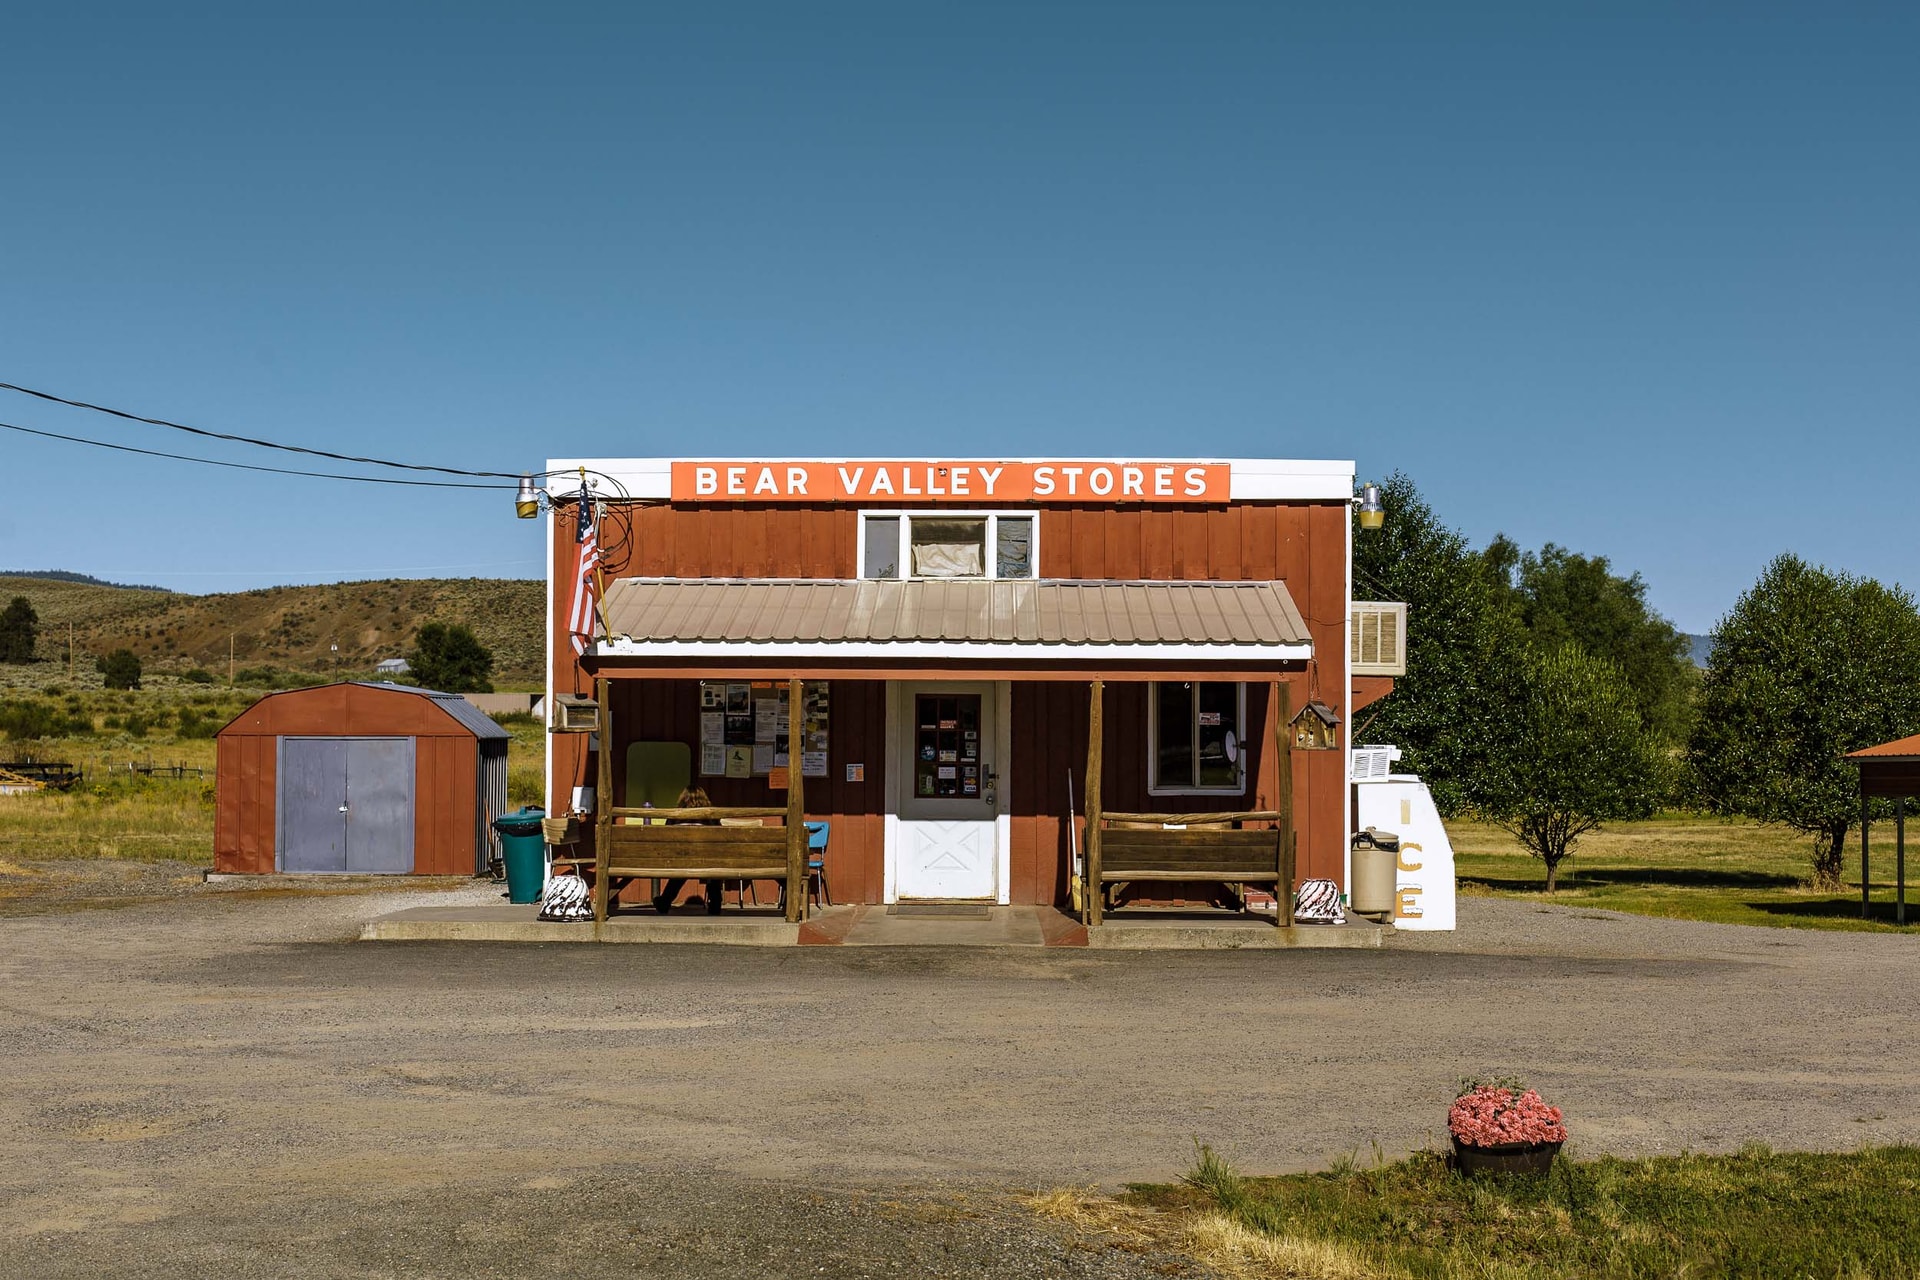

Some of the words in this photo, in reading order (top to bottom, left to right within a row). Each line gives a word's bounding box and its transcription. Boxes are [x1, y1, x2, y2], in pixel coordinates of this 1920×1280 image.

[695, 467, 808, 495] BEAR
[838, 467, 1004, 495] VALLEY
[1032, 467, 1207, 496] STORES
[1395, 799, 1423, 919] ICE
